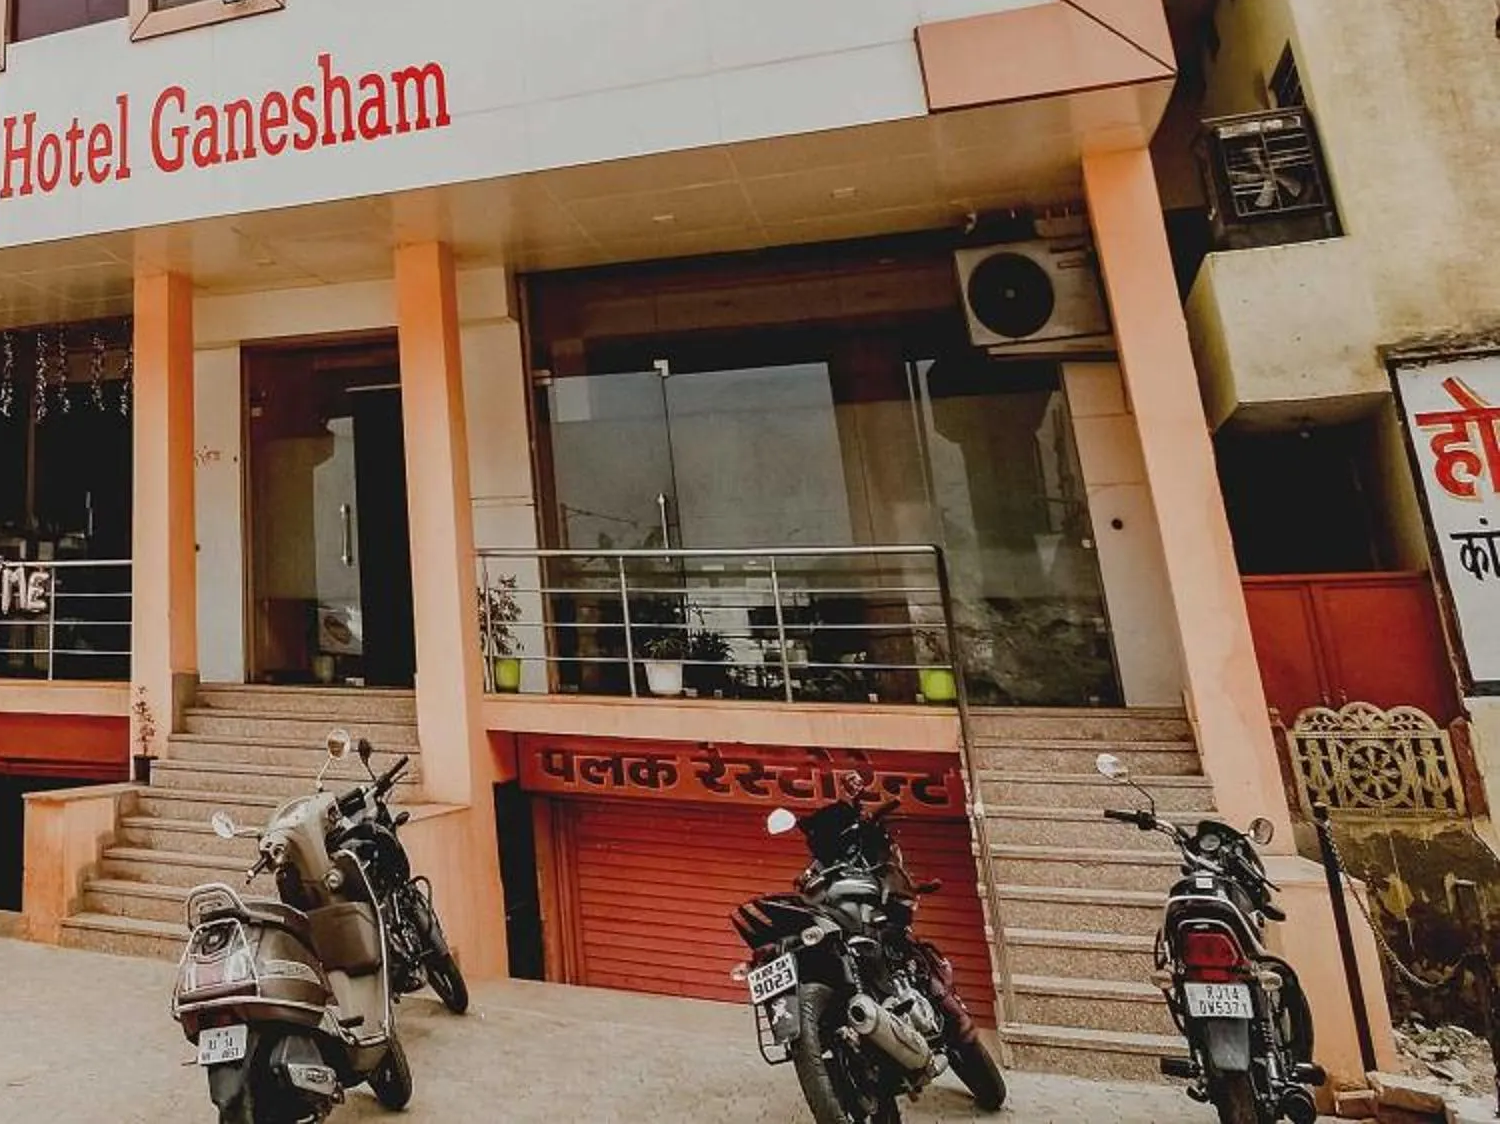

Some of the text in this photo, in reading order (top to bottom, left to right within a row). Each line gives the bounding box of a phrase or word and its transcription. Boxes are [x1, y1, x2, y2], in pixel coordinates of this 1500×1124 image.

[0, 54, 450, 199] Hotel Ganesham
[536, 748, 681, 790] पलक
[754, 968, 793, 999] 9023
